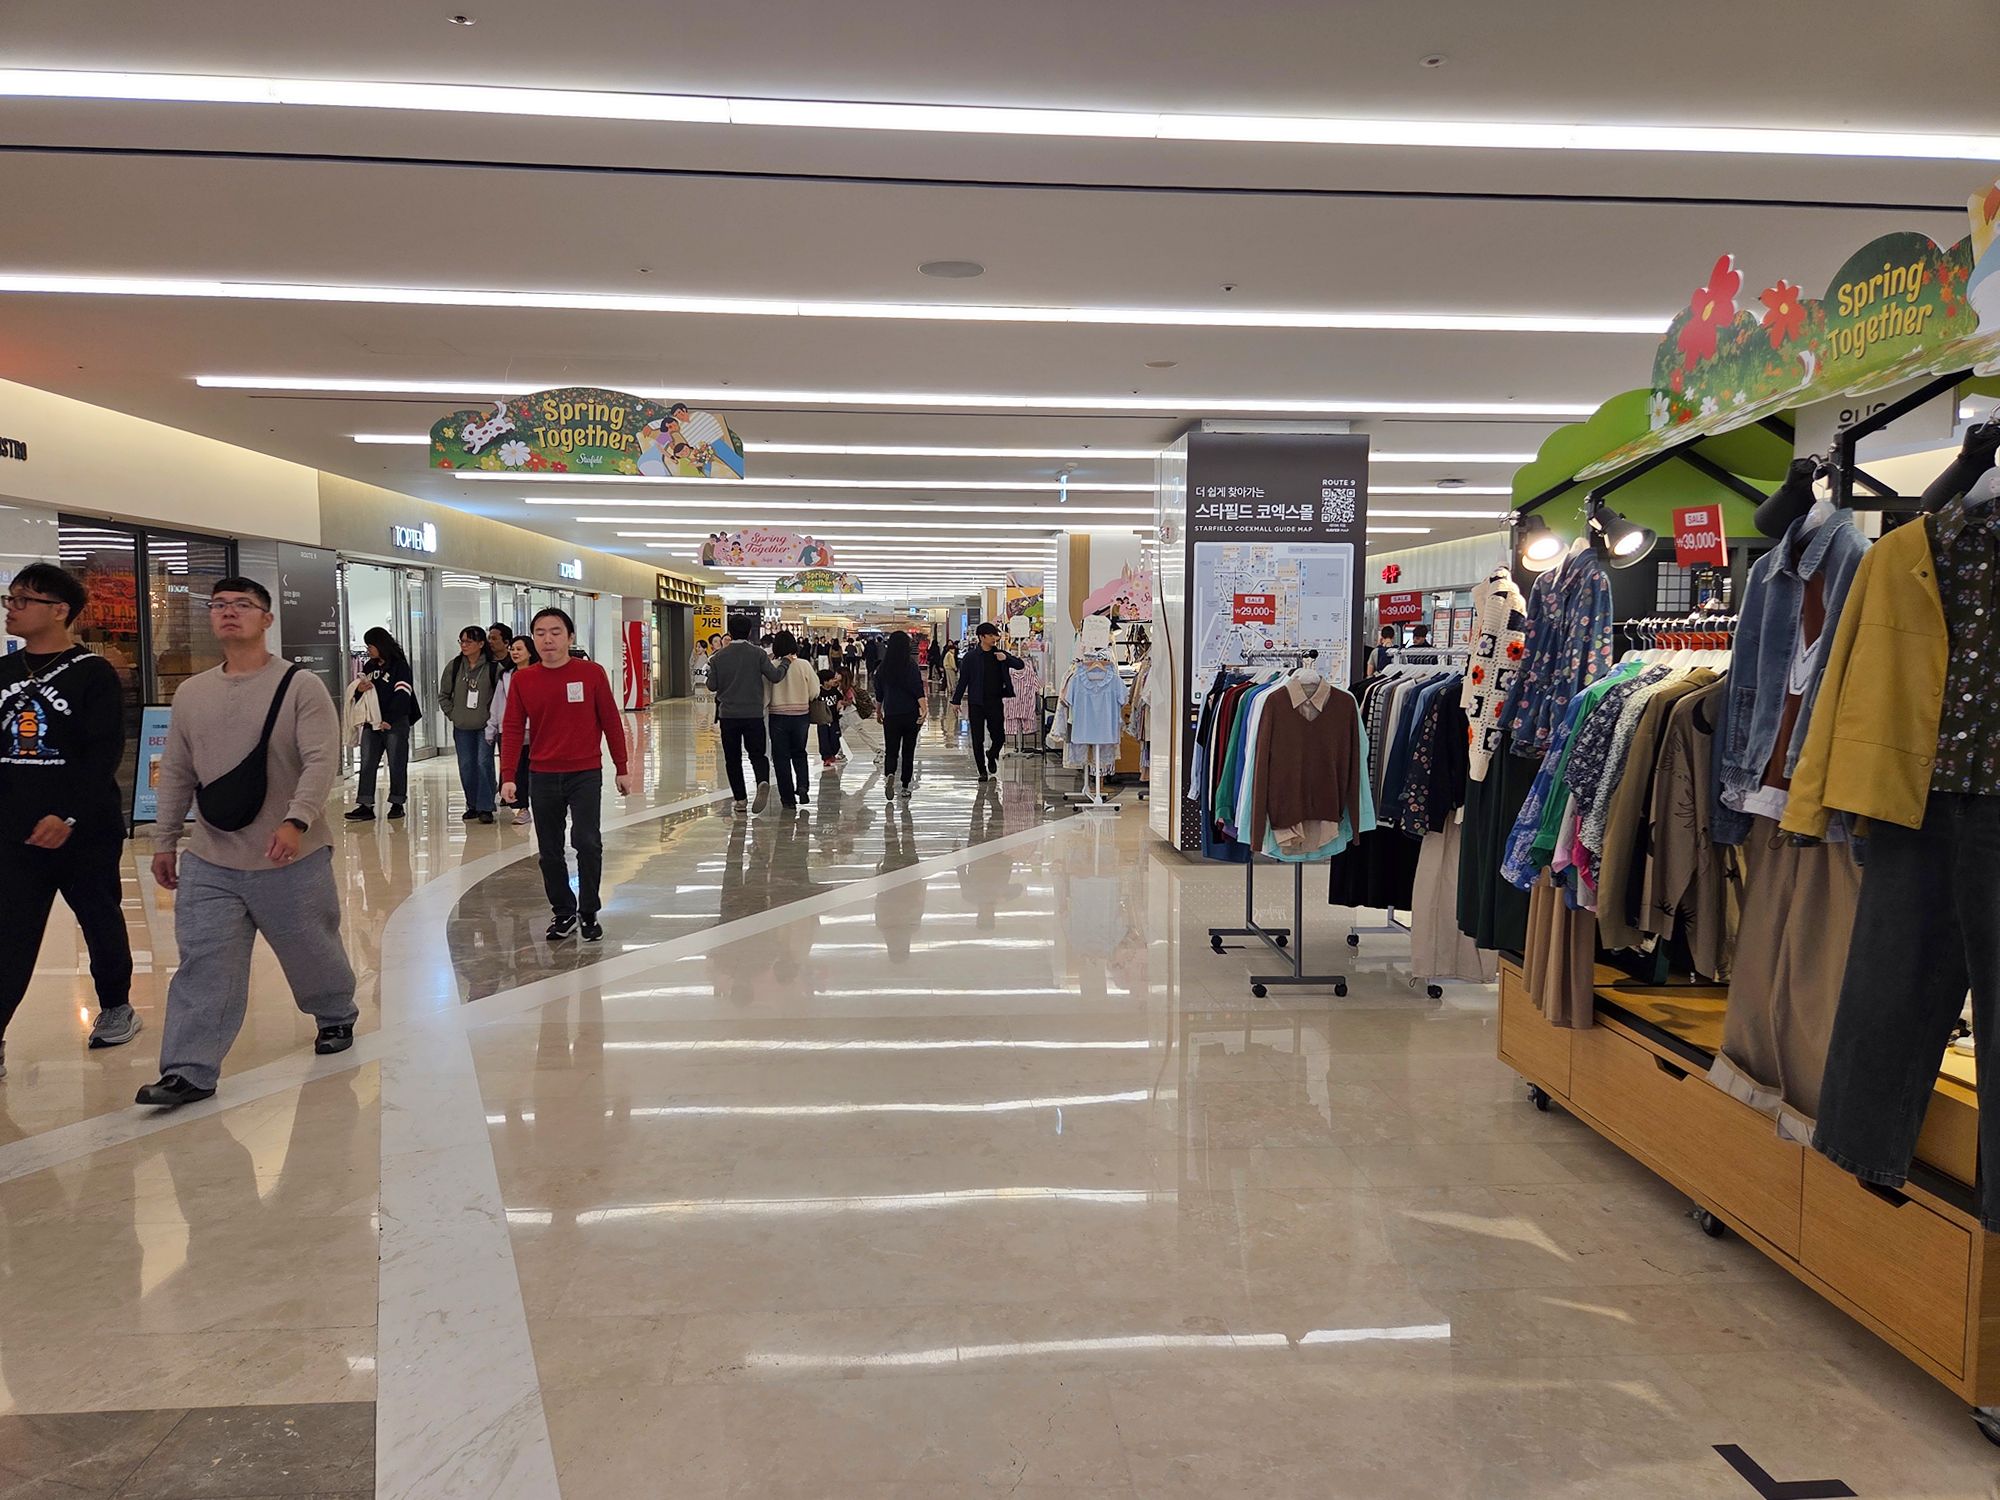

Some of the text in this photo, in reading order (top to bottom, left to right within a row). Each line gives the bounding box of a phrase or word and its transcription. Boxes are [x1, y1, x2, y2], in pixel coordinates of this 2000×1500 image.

[1837, 261, 1925, 318] Spring
[1827, 301, 1934, 361] Together
[543, 398, 625, 431] Spring
[533, 424, 635, 453] Together
[1195, 487, 1265, 498] 더 쉽게 찾아가는
[1195, 503, 1314, 521] 스타필드 코엑스몰
[1688, 513, 1705, 525] SALE
[1194, 525, 1233, 533] STARFIELD
[1234, 525, 1272, 533] COEXMALL
[1274, 525, 1296, 533] GUIDE
[751, 532, 787, 546] Spring
[745, 543, 790, 556] Together
[702, 617, 722, 628] 가연
